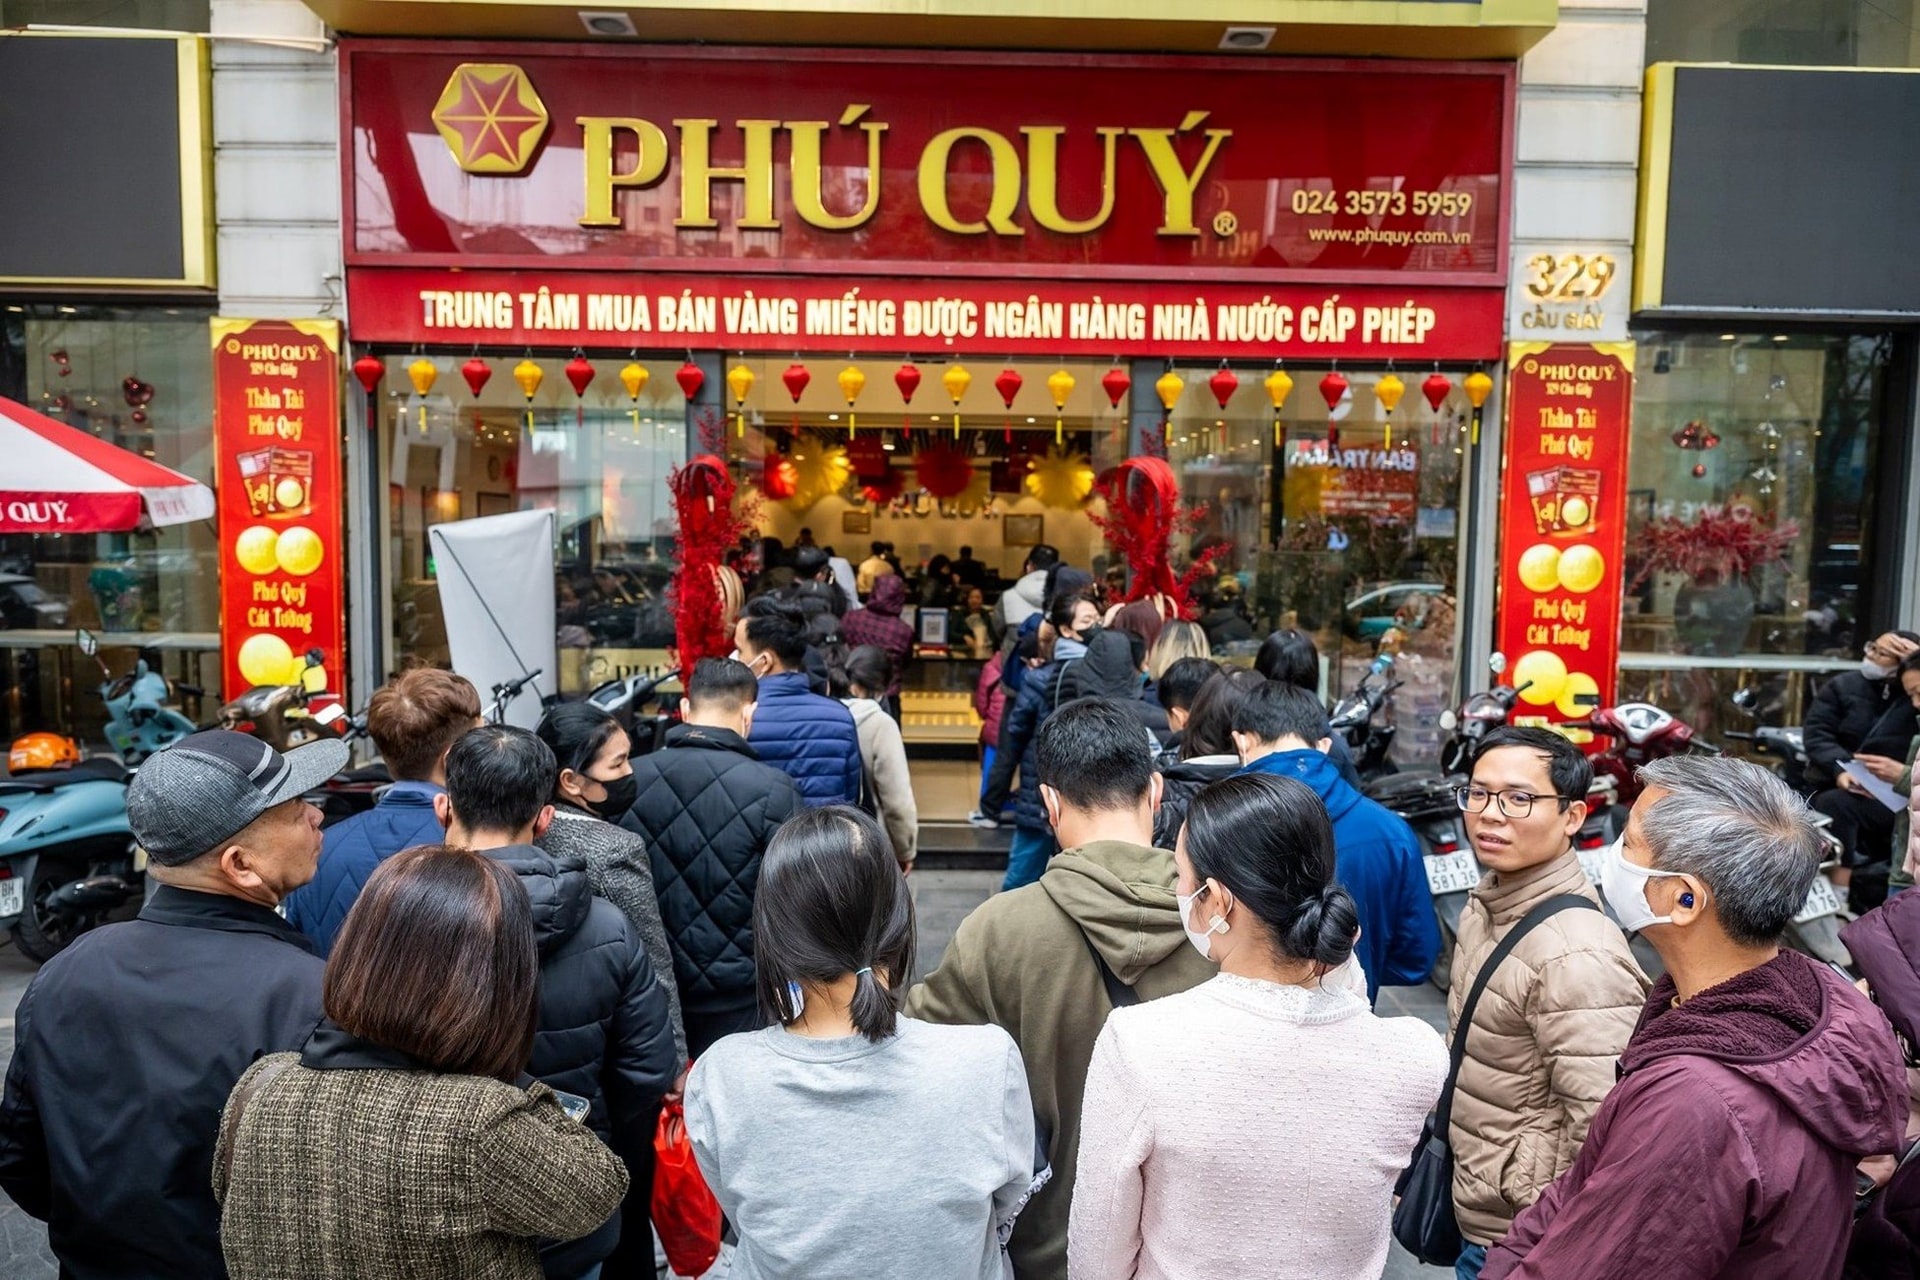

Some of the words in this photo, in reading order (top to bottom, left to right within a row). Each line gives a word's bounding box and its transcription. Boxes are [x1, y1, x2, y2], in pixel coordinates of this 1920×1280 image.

[576, 104, 889, 229] PHÚ
[918, 111, 1233, 236] QUÝ
[1292, 190, 1339, 215] 024
[1345, 190, 1406, 216] 3573
[1412, 191, 1472, 217] 5959
[1309, 227, 1471, 247] www.phuquy.com.vn
[1525, 253, 1616, 297] 329
[419, 290, 513, 328] TRUNG
[519, 286, 580, 330] TÂM
[587, 294, 651, 331] MUA
[658, 289, 716, 333] BÁN
[722, 290, 798, 334] VÀNG
[805, 287, 897, 336] MIẾNG
[902, 297, 978, 345] ĐƯỢC
[984, 295, 1063, 338] NGÂN
[1069, 296, 1146, 340] HÀNG
[1152, 297, 1211, 341] NHÀ
[1217, 295, 1293, 342] NƯỚC
[1300, 294, 1356, 343] CẤP
[1362, 300, 1435, 344] PHÉP
[1521, 304, 1558, 330] CẦU
[242, 343, 280, 361] PHÚ
[281, 344, 320, 361] QUÝ
[1540, 363, 1576, 381] PHÚ
[1577, 364, 1616, 381] QUÝ
[245, 386, 281, 409] Thần
[282, 387, 304, 409] Tài
[248, 413, 275, 436] Phú
[276, 414, 303, 442] Quý
[1539, 406, 1574, 428] Thần
[1575, 407, 1597, 429] Tài
[1540, 433, 1566, 455] Phú
[1567, 434, 1594, 461] Quý
[253, 579, 279, 602] Phú
[281, 581, 307, 608] Quý
[248, 606, 270, 628] Cát
[272, 606, 313, 634] Tường
[1533, 597, 1559, 619] Phú
[1560, 598, 1587, 625] Quý
[1526, 623, 1549, 645] Cát
[1551, 623, 1591, 651] Tường
